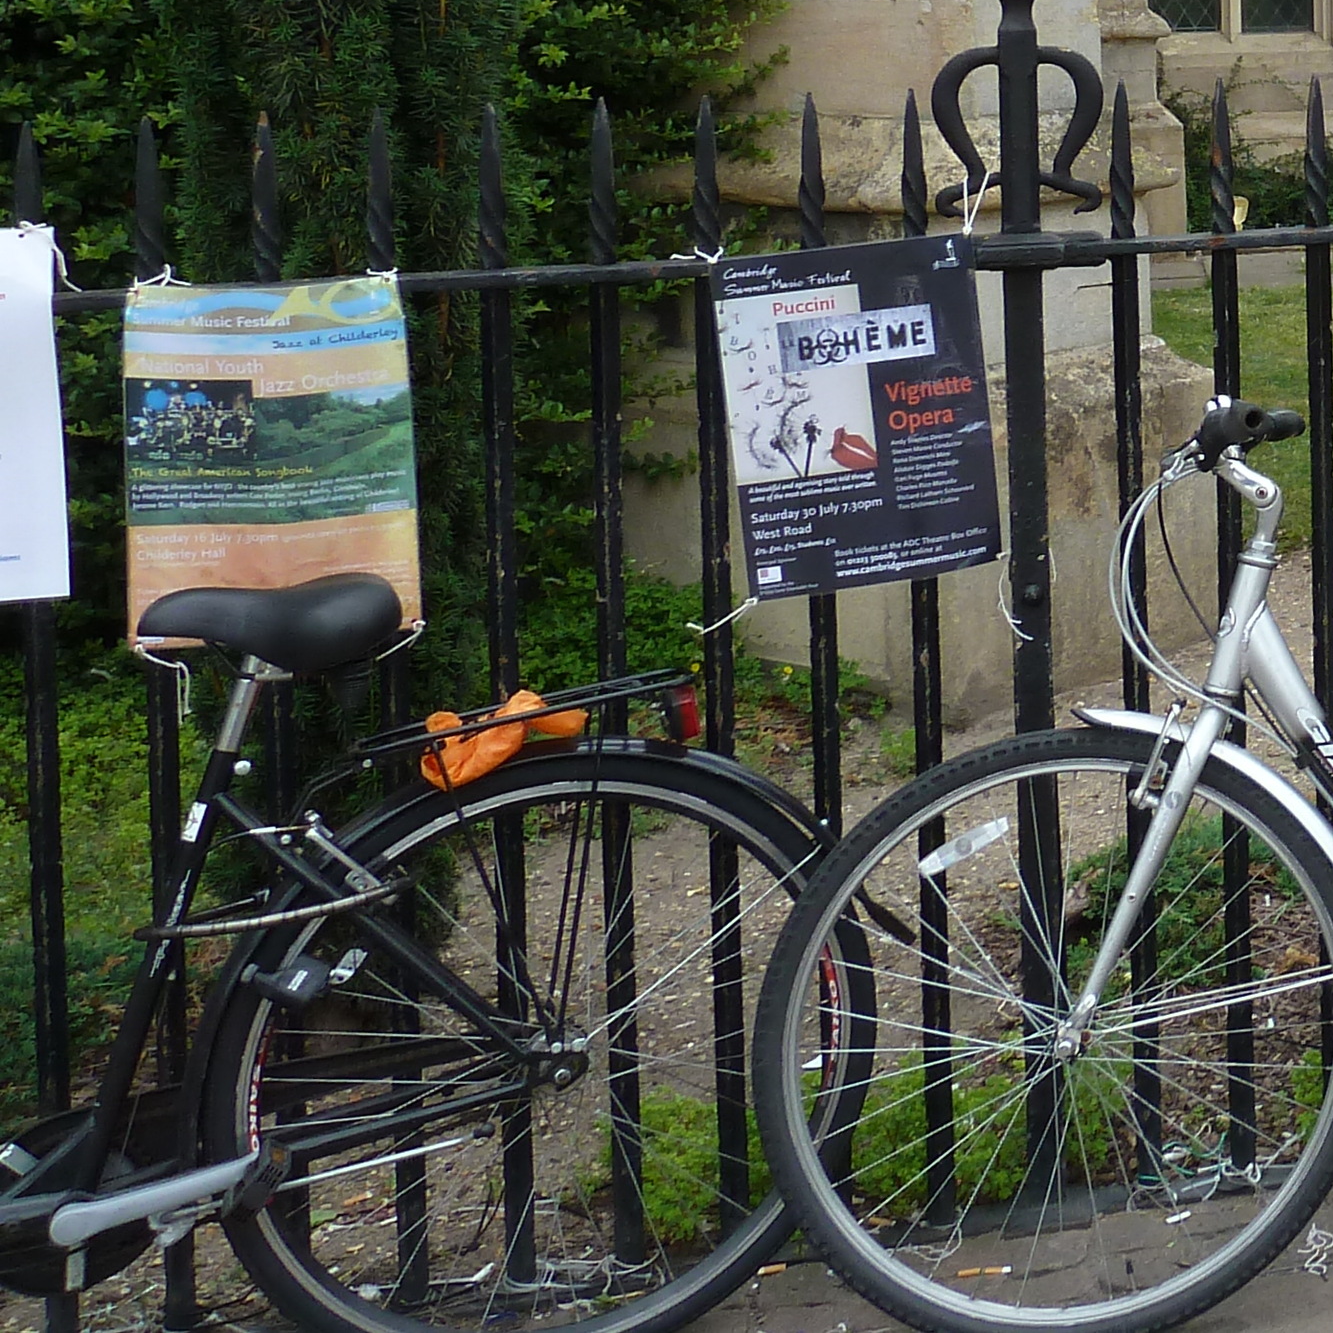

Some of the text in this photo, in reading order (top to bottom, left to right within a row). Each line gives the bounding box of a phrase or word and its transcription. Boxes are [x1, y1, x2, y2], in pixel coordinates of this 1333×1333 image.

[722, 263, 778, 281] Cambridge
[807, 269, 851, 286] Festival
[771, 294, 835, 316] Puccini
[191, 316, 231, 328] Music
[236, 314, 290, 328] Festival
[136, 357, 264, 375] National Youth
[260, 367, 392, 397] Jazz Orchestra
[884, 375, 972, 406] Vignette
[887, 407, 954, 434] Opera
[254, 465, 313, 480] Songbook
[751, 496, 884, 525] Saturday 30 July 7.30pm
[136, 533, 188, 546] Saturday
[752, 523, 813, 541] West Road
[136, 547, 226, 562] Childerley Hall
[855, 545, 880, 555] tickets
